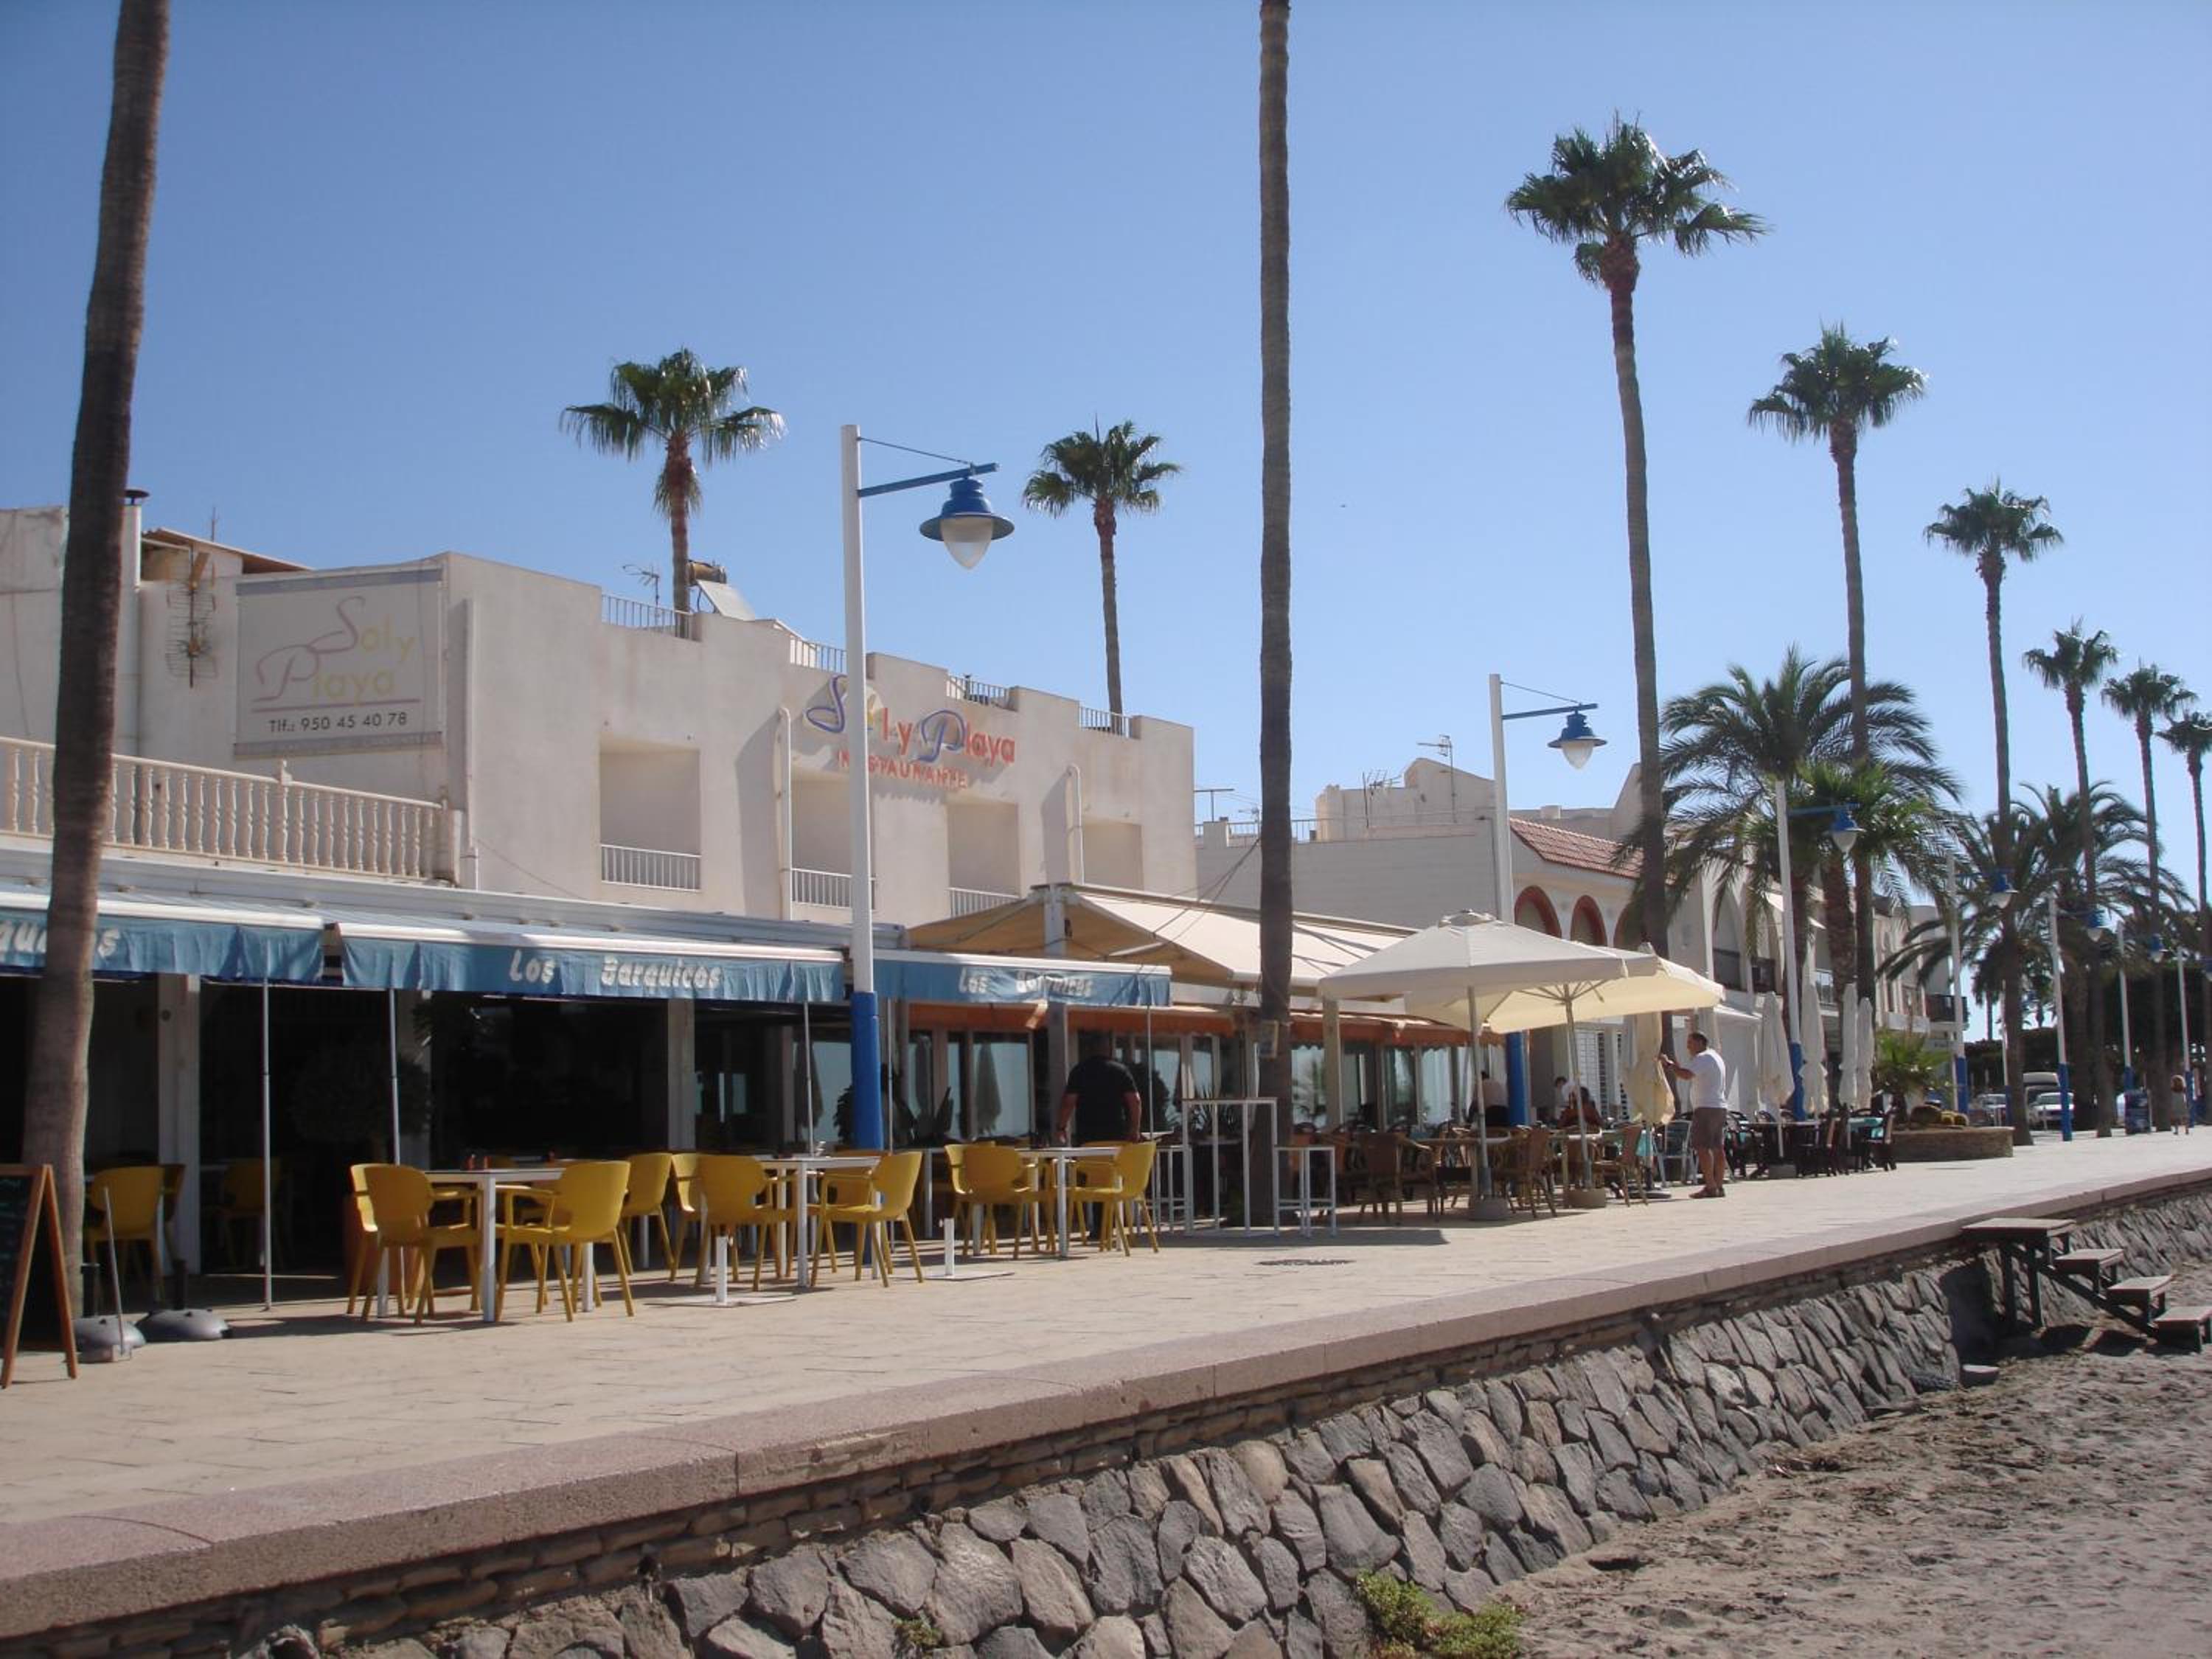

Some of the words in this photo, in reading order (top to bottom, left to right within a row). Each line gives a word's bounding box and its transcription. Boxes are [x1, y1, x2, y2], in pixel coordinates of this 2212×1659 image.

[301, 717, 331, 732] 950
[336, 714, 356, 729] 45
[363, 712, 382, 727] 40
[388, 712, 407, 726] 78
[918, 709, 1015, 768] Playa
[509, 949, 555, 984] Los
